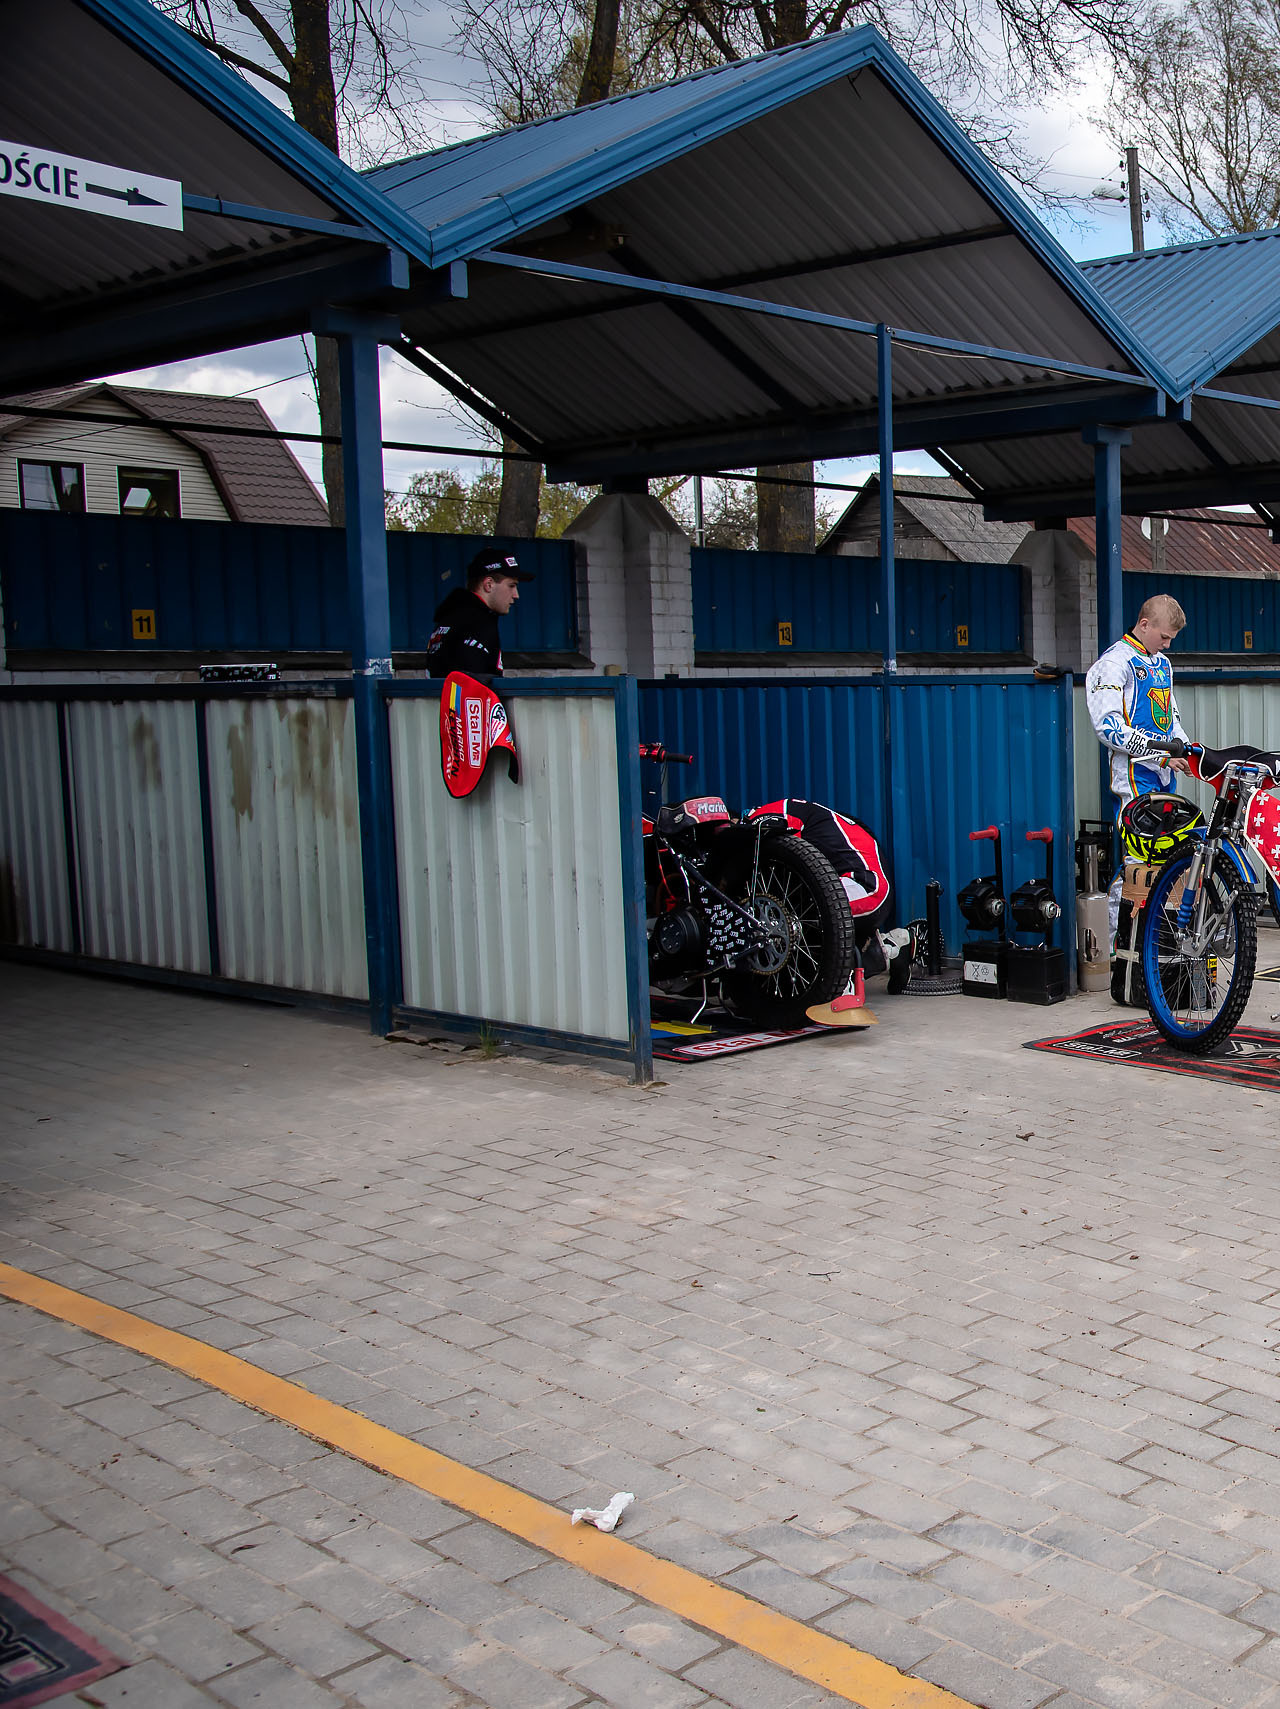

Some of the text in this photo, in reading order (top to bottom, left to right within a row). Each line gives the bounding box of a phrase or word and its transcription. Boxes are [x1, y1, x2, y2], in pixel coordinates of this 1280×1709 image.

[135, 615, 152, 633] 11
[779, 627, 791, 642] 13
[957, 629, 967, 642] 14
